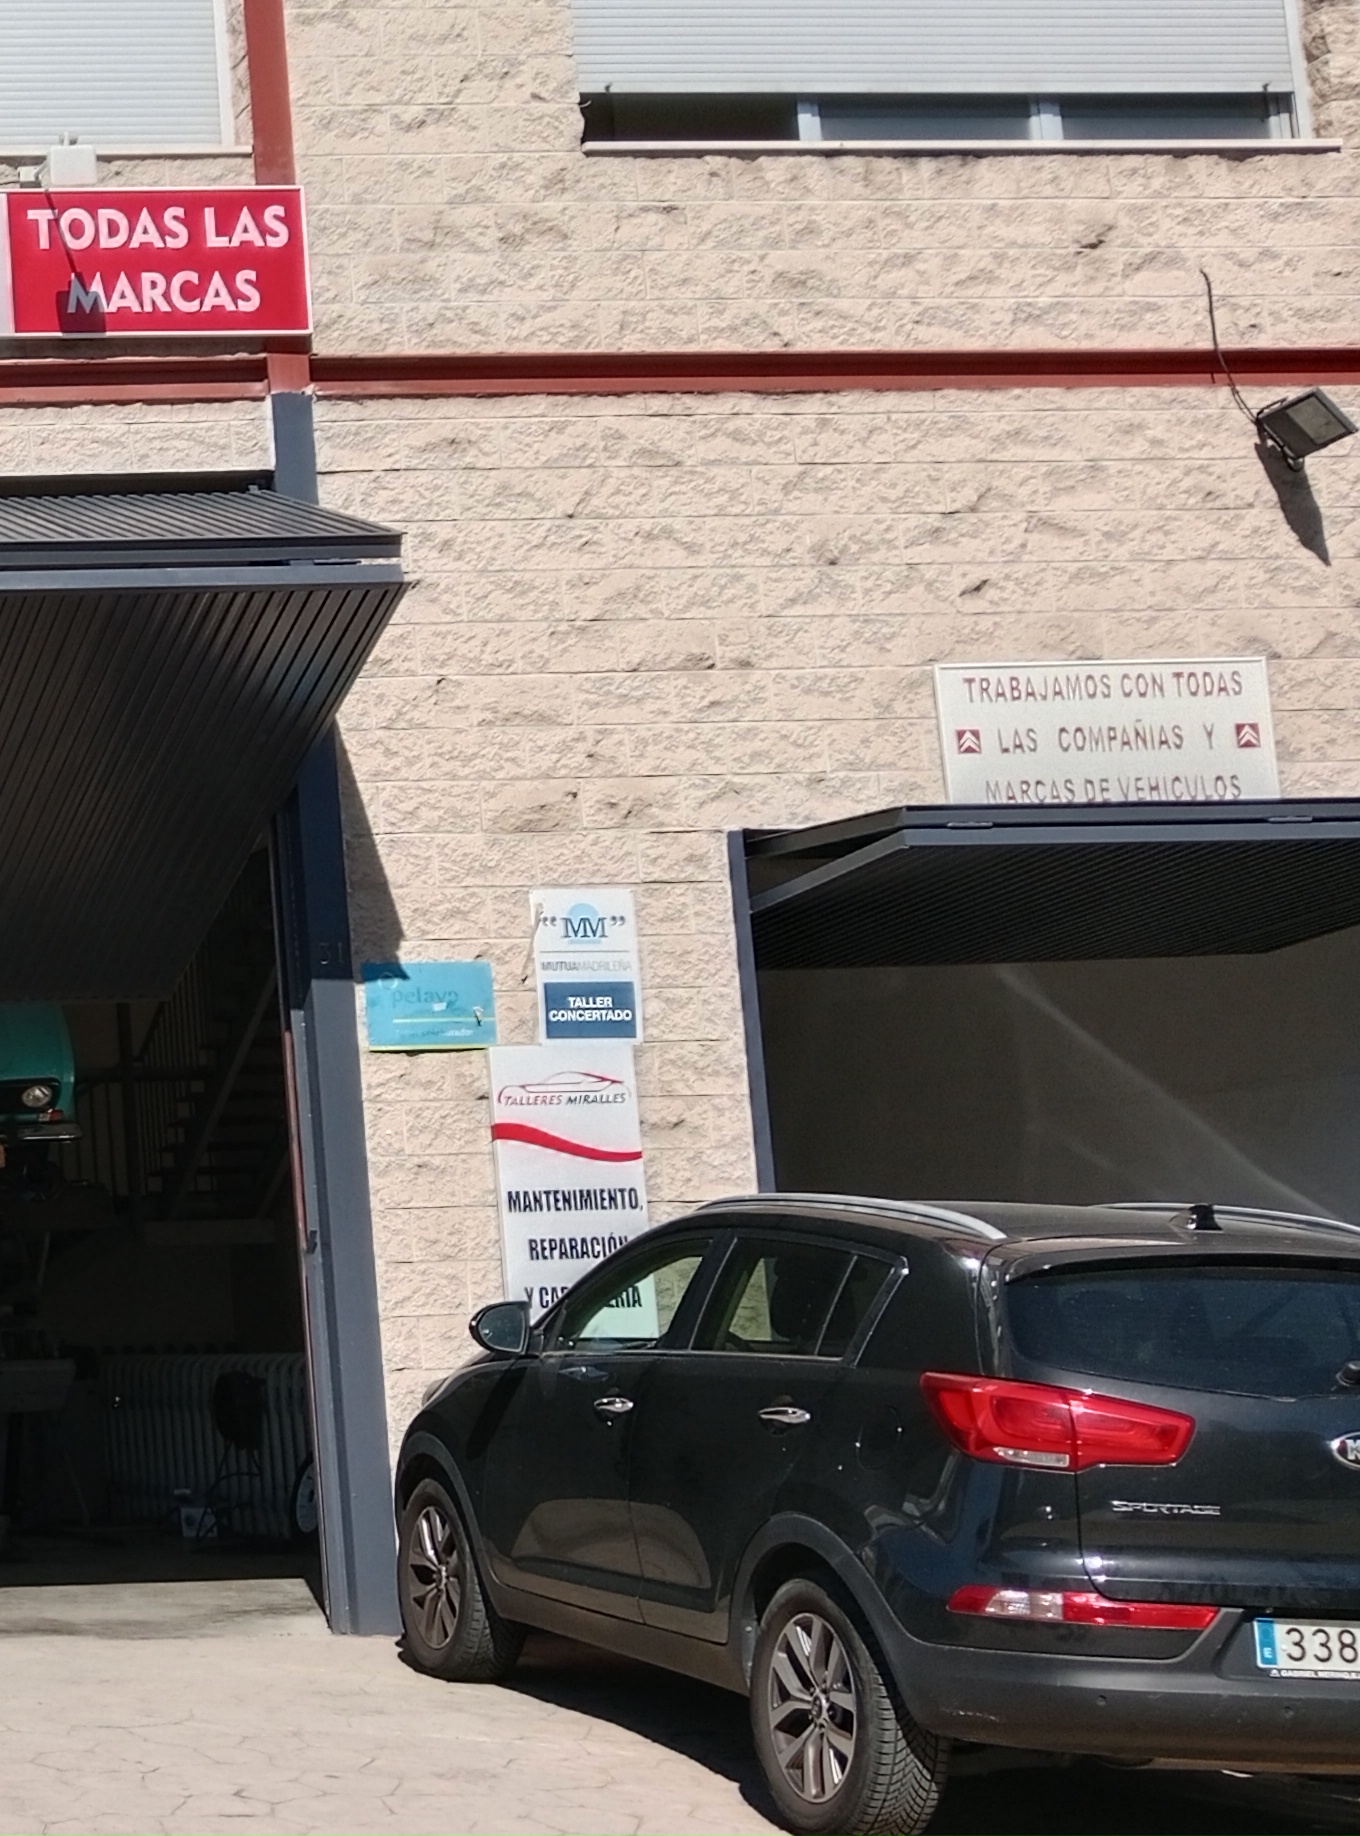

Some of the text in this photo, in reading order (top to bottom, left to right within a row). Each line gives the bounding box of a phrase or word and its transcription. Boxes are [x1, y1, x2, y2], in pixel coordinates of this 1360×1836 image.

[27, 205, 289, 250] TODAS LAS
[67, 269, 261, 313] MARCAS
[962, 670, 1243, 703] TRABAJAMOS CON TODAS
[998, 719, 1215, 754] LAS COMPAÑIAS Y
[985, 775, 1242, 804] MARCAS DE VEHICULOS
[549, 1009, 633, 1021] CONCERTADO
[568, 996, 613, 1008] TALLER
[503, 1093, 626, 1106] TALLERES MIRALLES
[508, 1188, 644, 1213] MANTENIMIENTO,
[1112, 1500, 1221, 1516] SPORTAGE
[1285, 1627, 1358, 1663] 338
